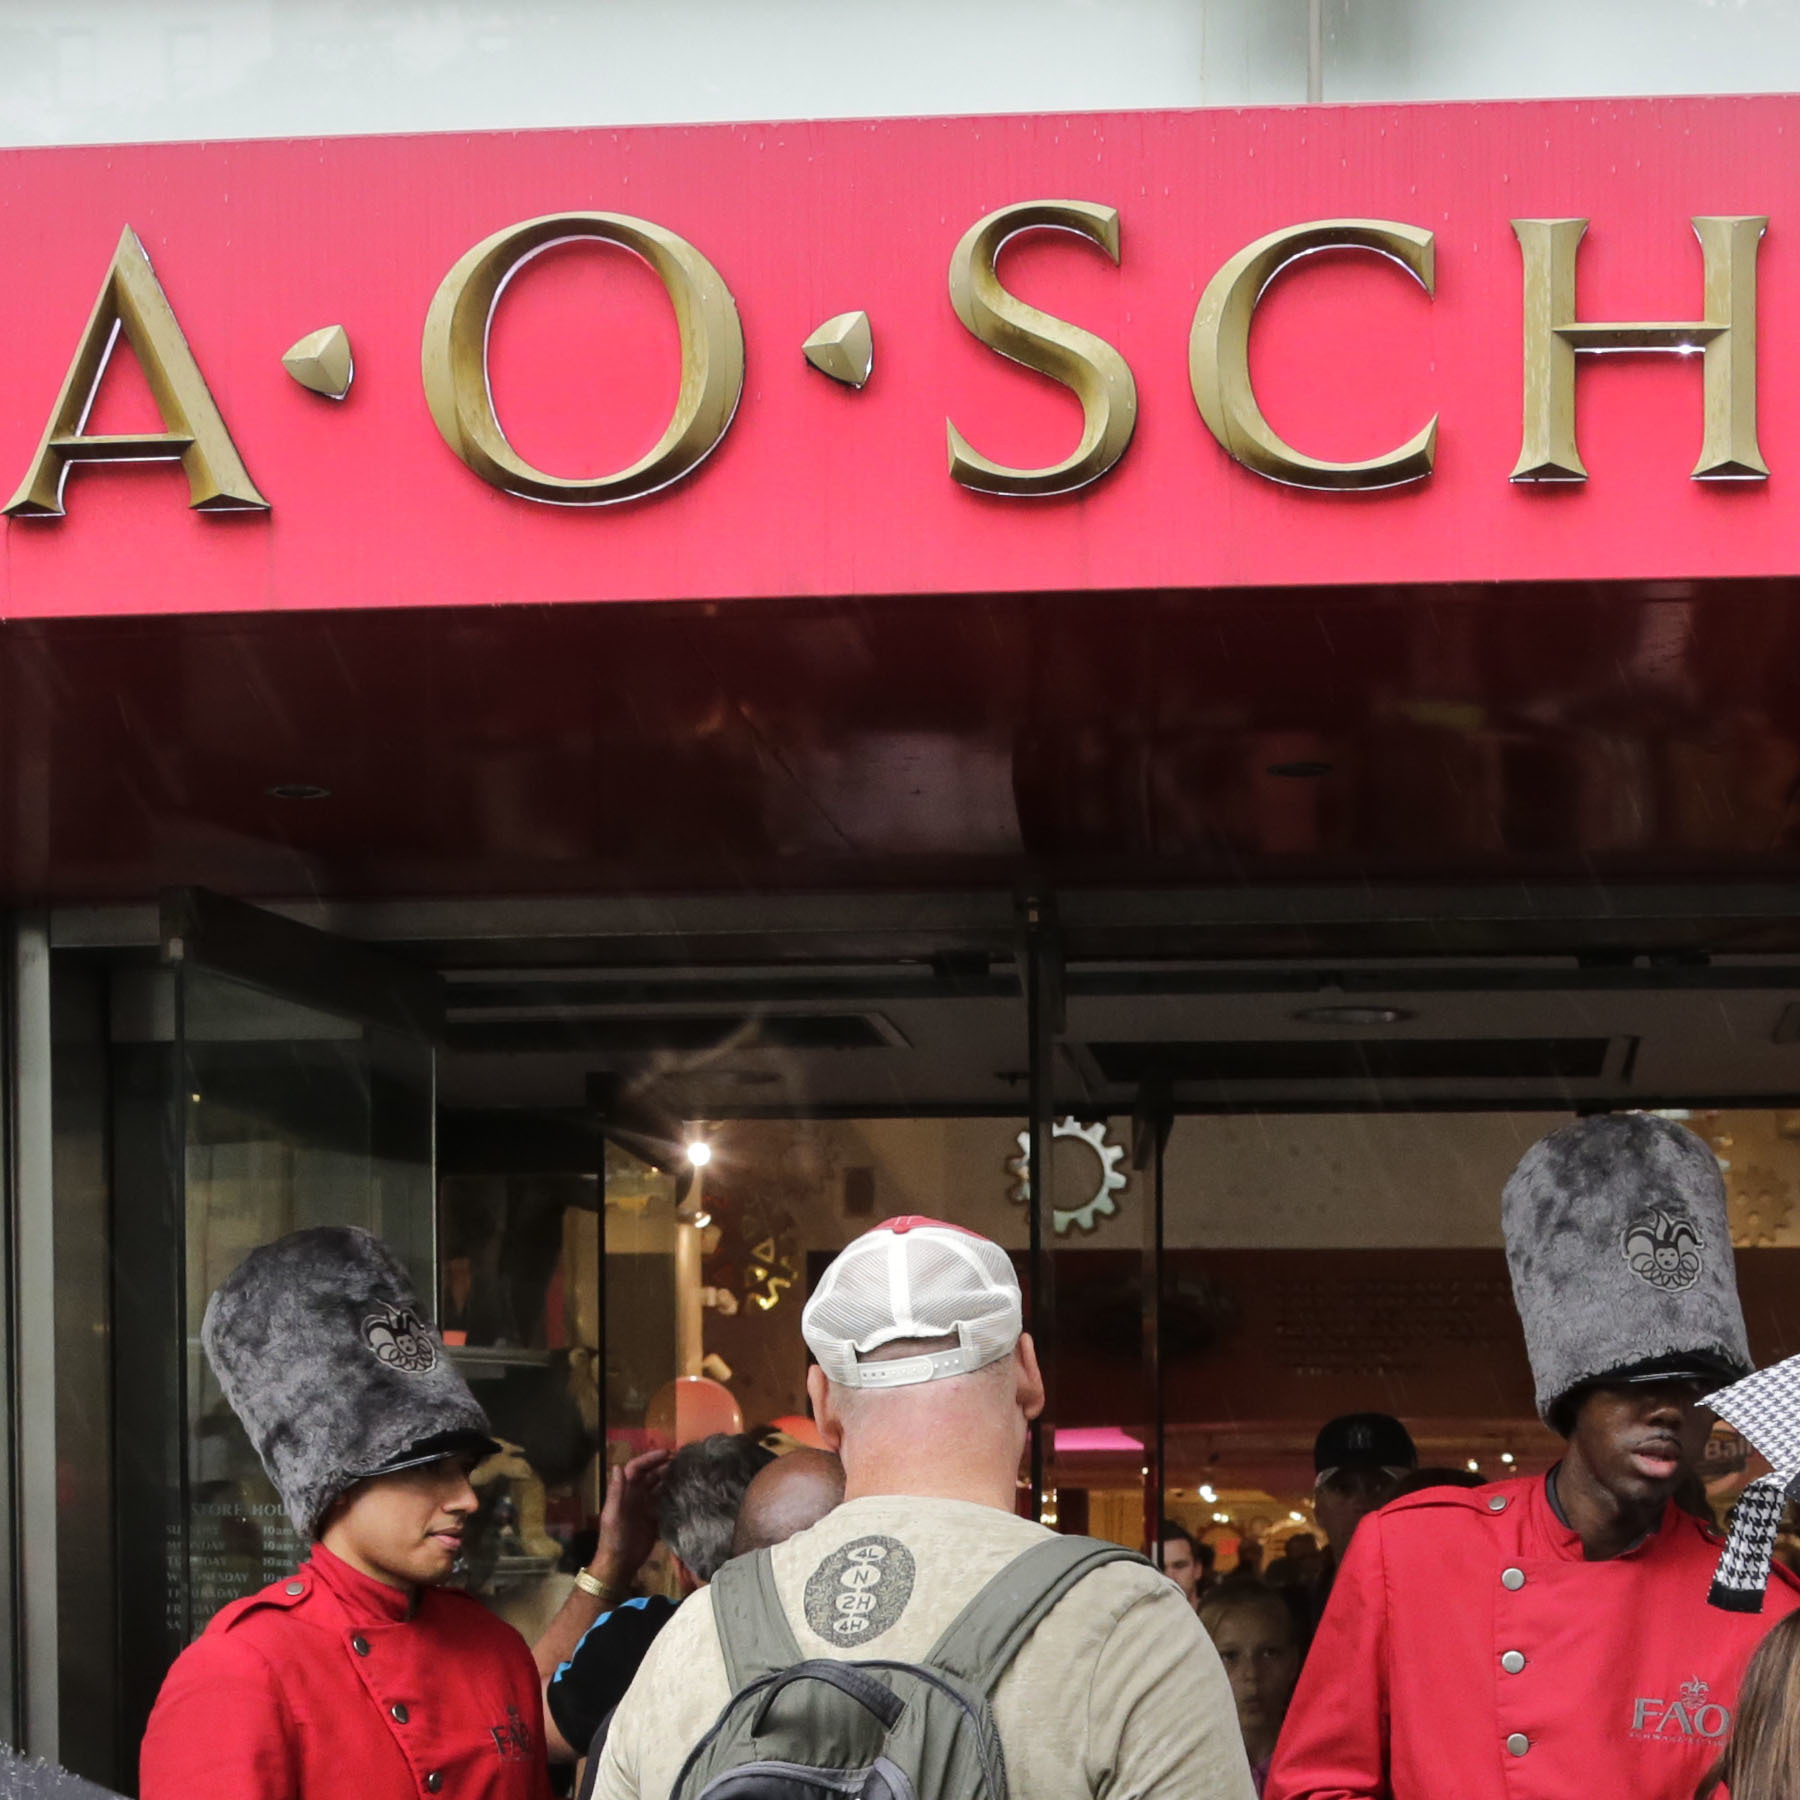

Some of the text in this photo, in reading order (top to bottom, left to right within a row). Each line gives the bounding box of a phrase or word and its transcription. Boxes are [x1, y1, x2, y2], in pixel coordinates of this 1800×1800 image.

[251, 1503, 287, 1516] HOU
[856, 1548, 879, 1559] 4L
[853, 1570, 869, 1585] N
[842, 1595, 871, 1610] 2H
[838, 1620, 862, 1631] 4H
[1631, 1697, 1731, 1738] FAO
